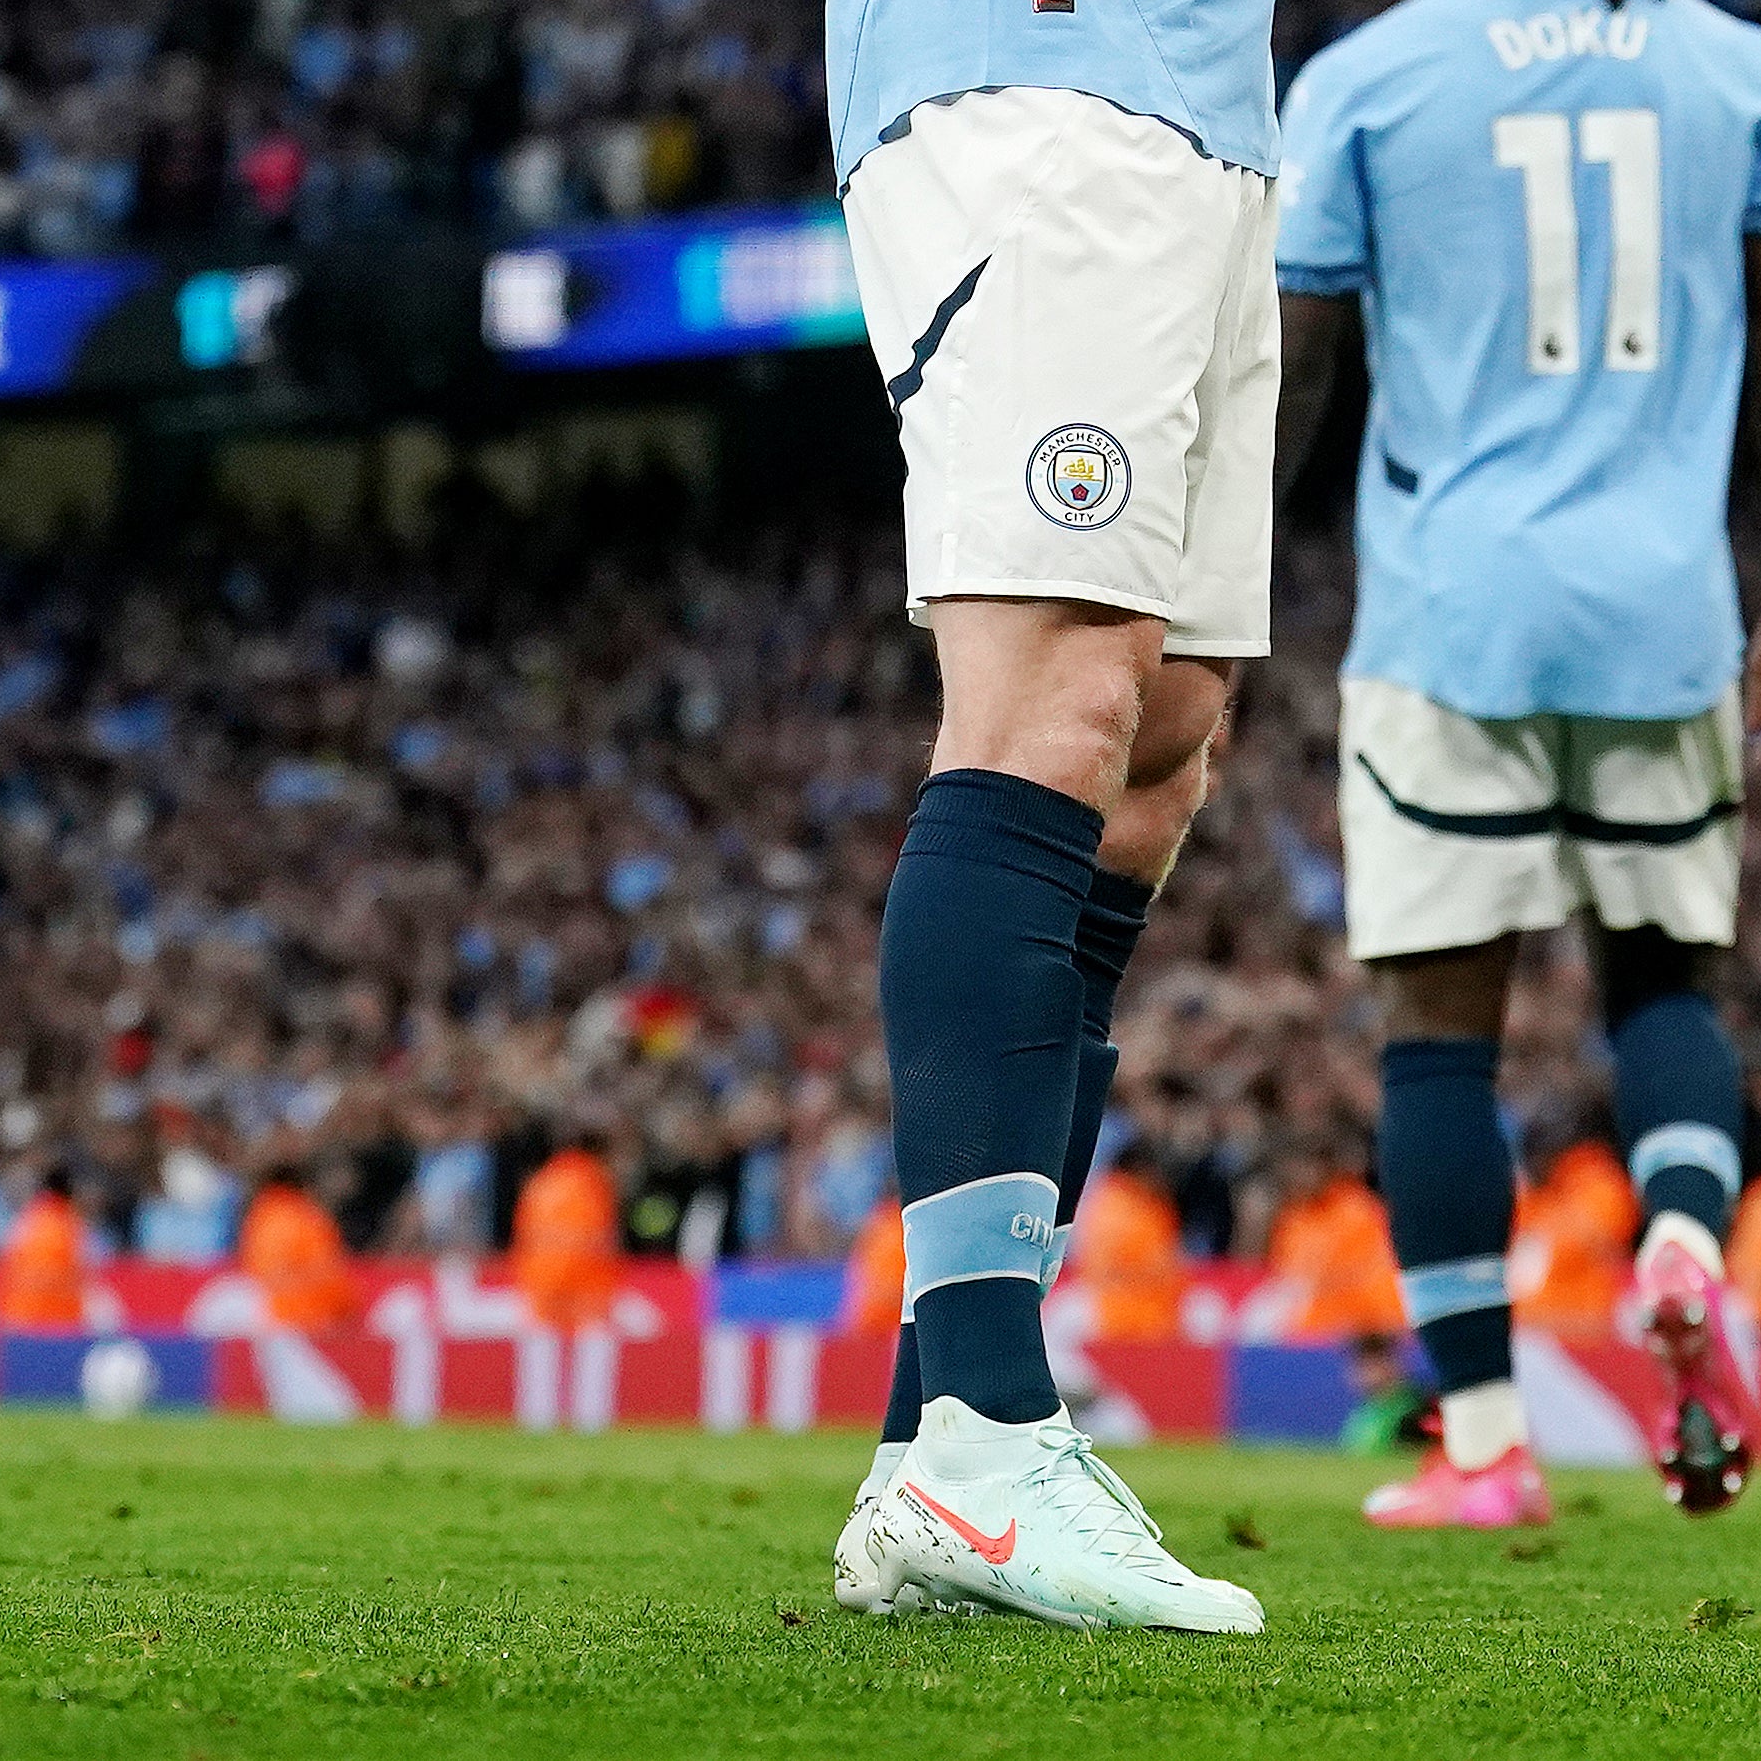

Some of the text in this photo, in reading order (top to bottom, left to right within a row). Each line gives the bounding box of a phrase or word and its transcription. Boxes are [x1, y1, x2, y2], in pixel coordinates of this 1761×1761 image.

[1488, 8, 1647, 69] DOKU
[1495, 111, 1660, 371] 11
[1040, 433, 1121, 467] MANCHESTER
[1064, 511, 1095, 523] CITY
